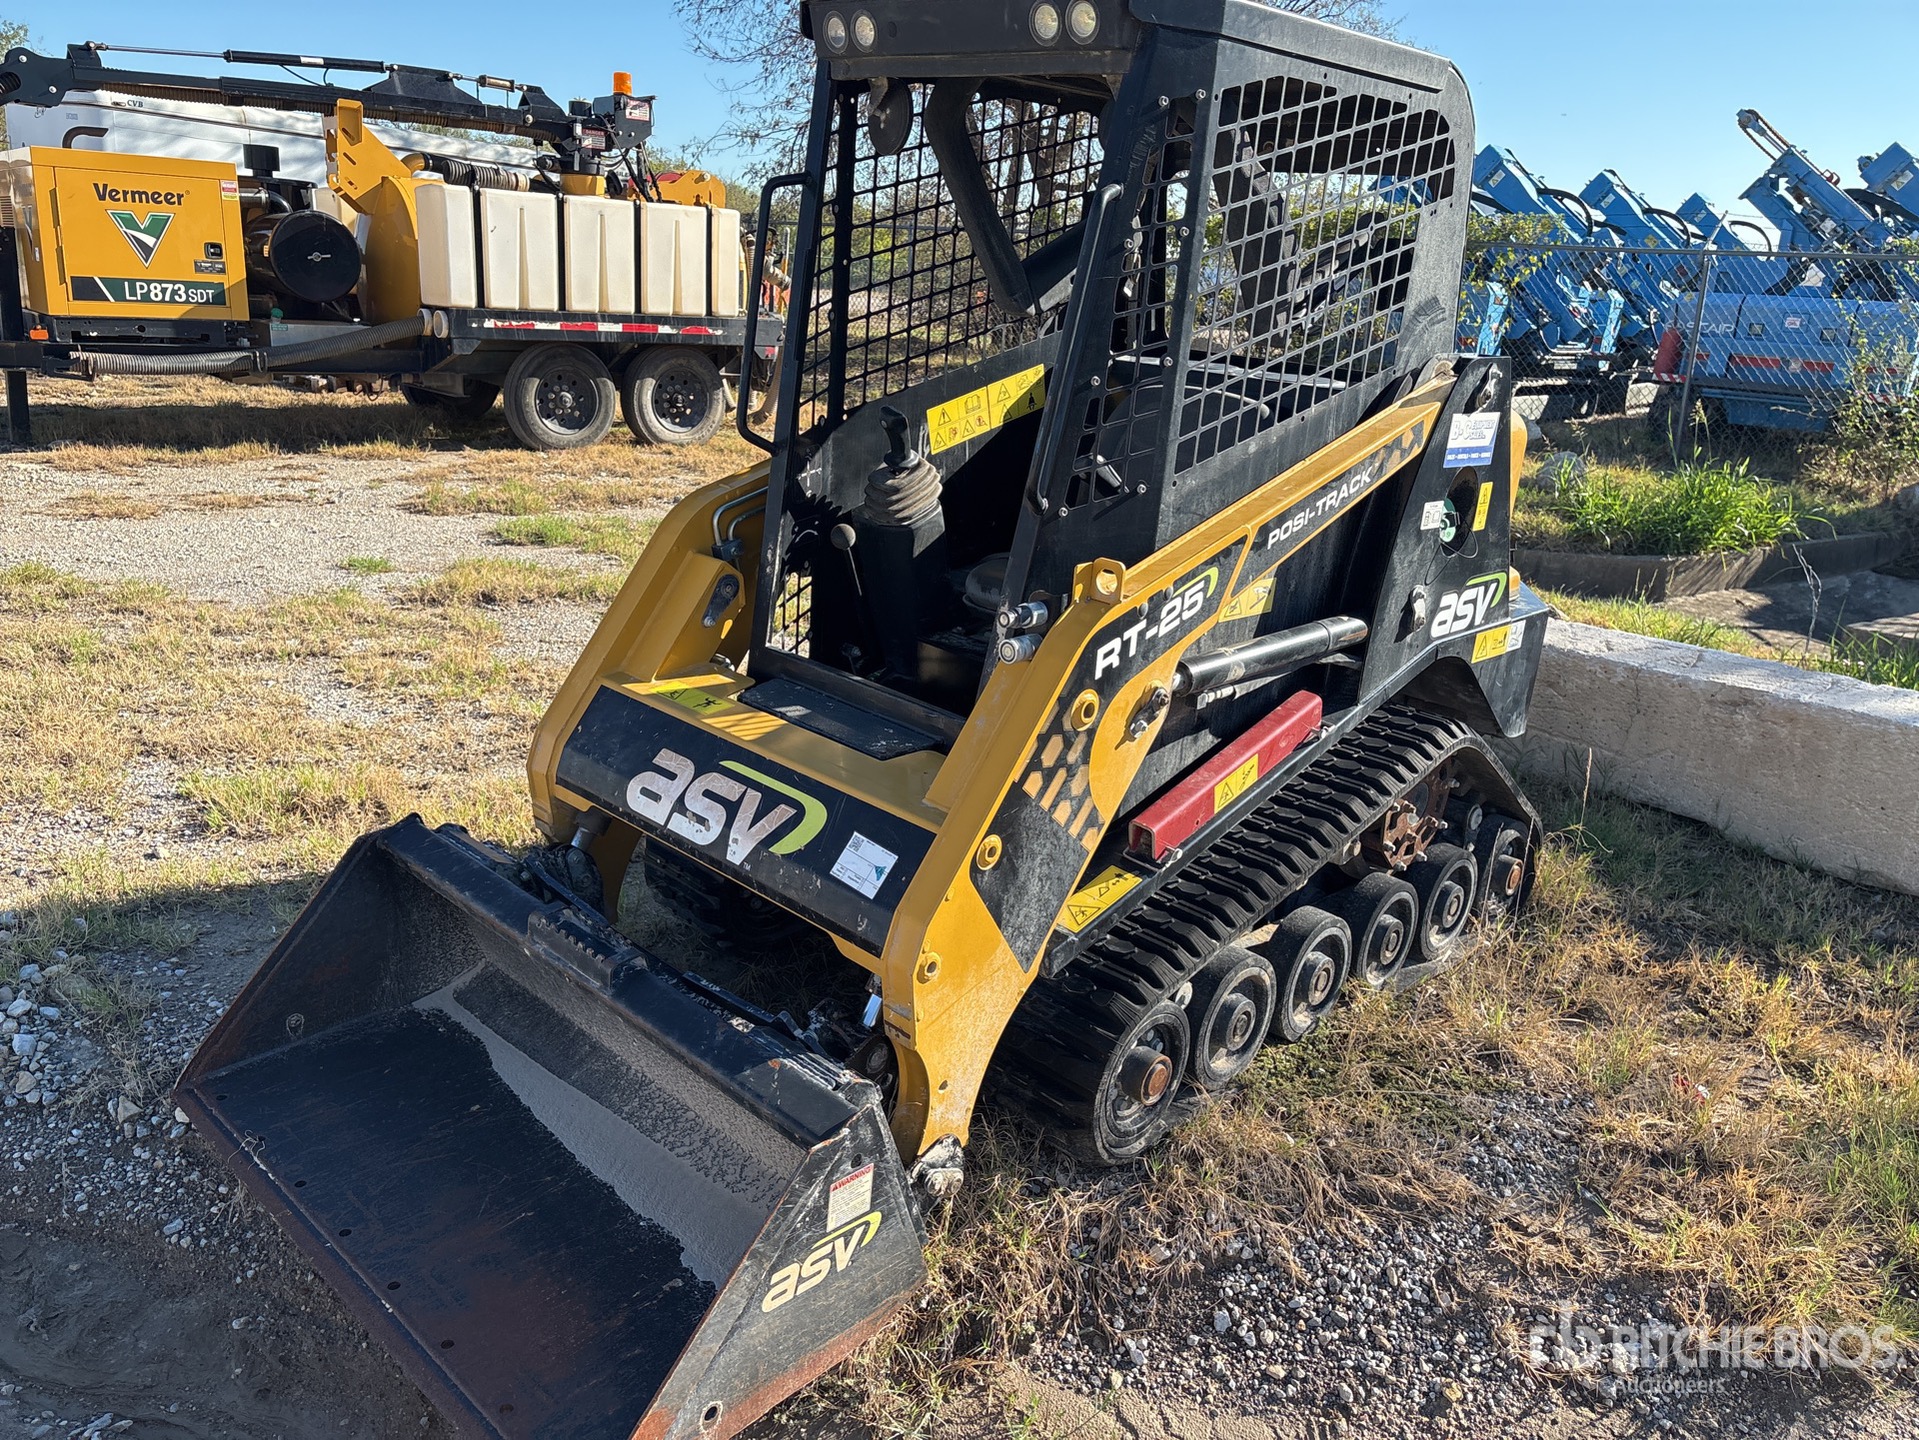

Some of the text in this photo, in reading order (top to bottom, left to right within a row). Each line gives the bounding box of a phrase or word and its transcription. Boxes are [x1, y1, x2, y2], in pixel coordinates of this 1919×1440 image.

[1267, 466, 1373, 550] POSI-TRACK
[1095, 580, 1204, 680] RT-25
[839, 1166, 872, 1188] WARNING
